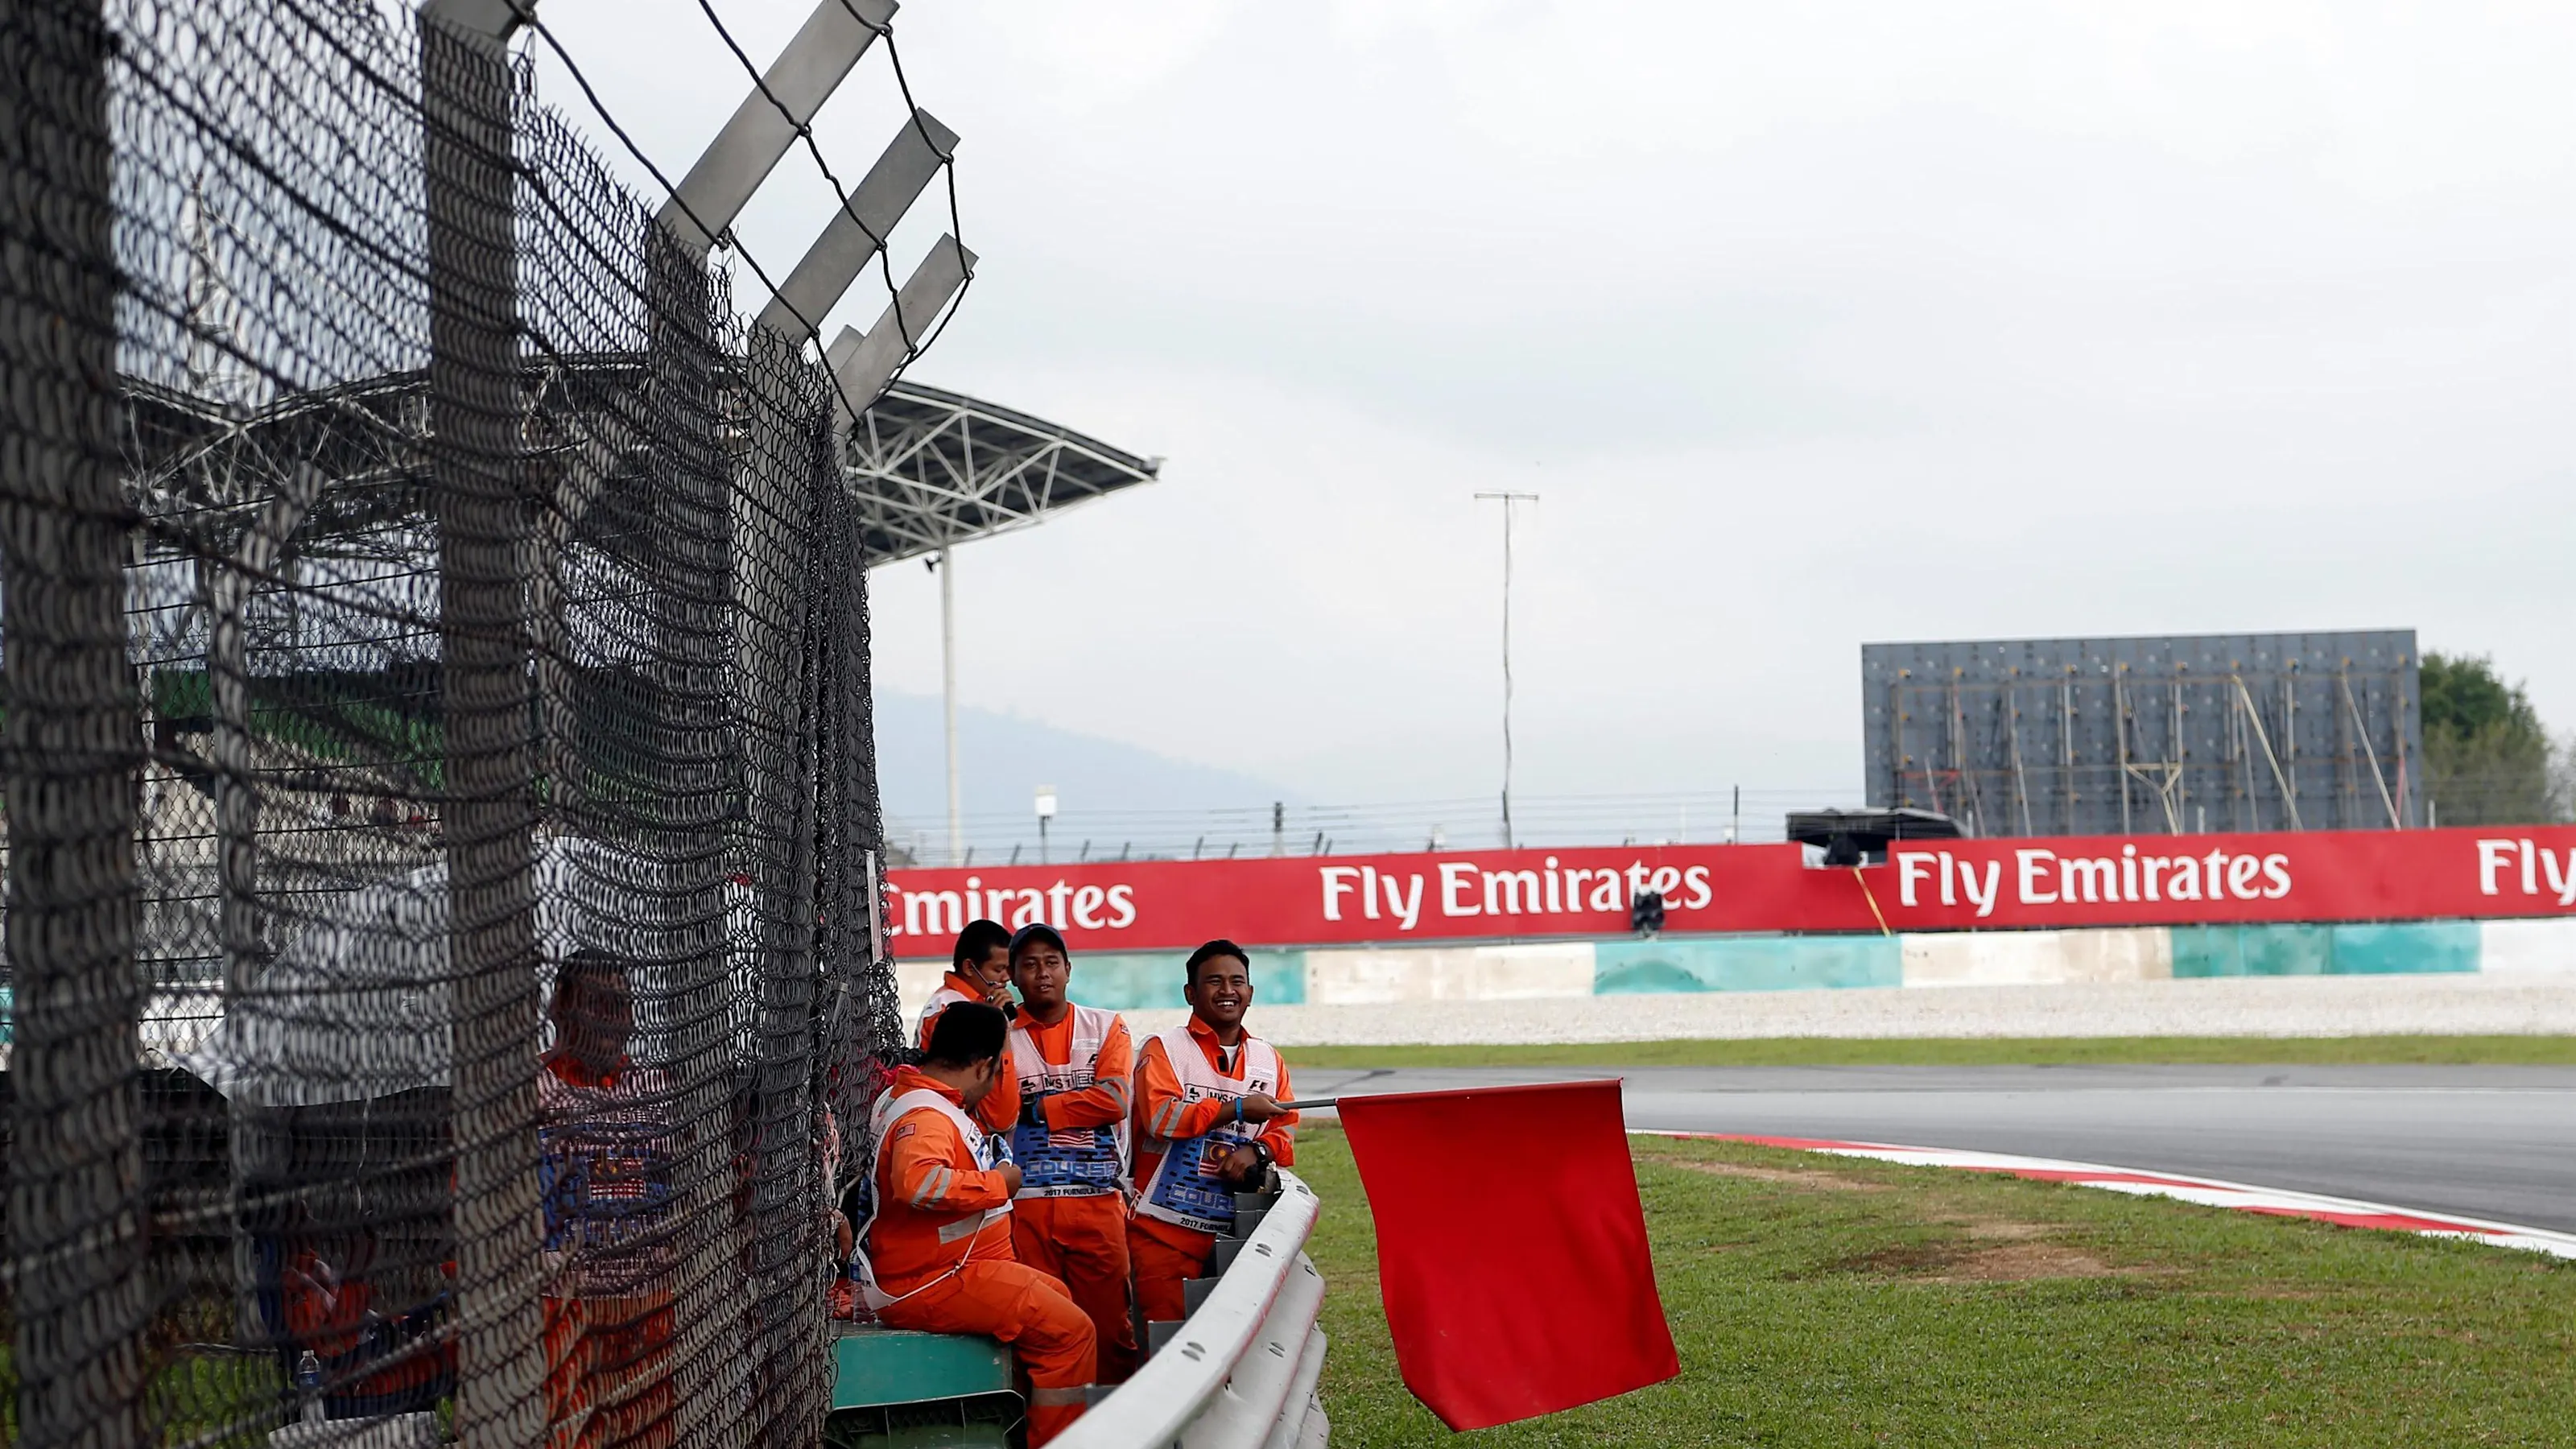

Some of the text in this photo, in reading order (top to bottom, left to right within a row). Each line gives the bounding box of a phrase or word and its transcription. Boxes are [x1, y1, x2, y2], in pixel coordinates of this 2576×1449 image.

[1319, 856, 1713, 931] Fly Emirates
[1897, 843, 2293, 918] Fly Emirates
[2475, 837, 2576, 906] Fly
[1180, 1217, 1198, 1228] 2017
